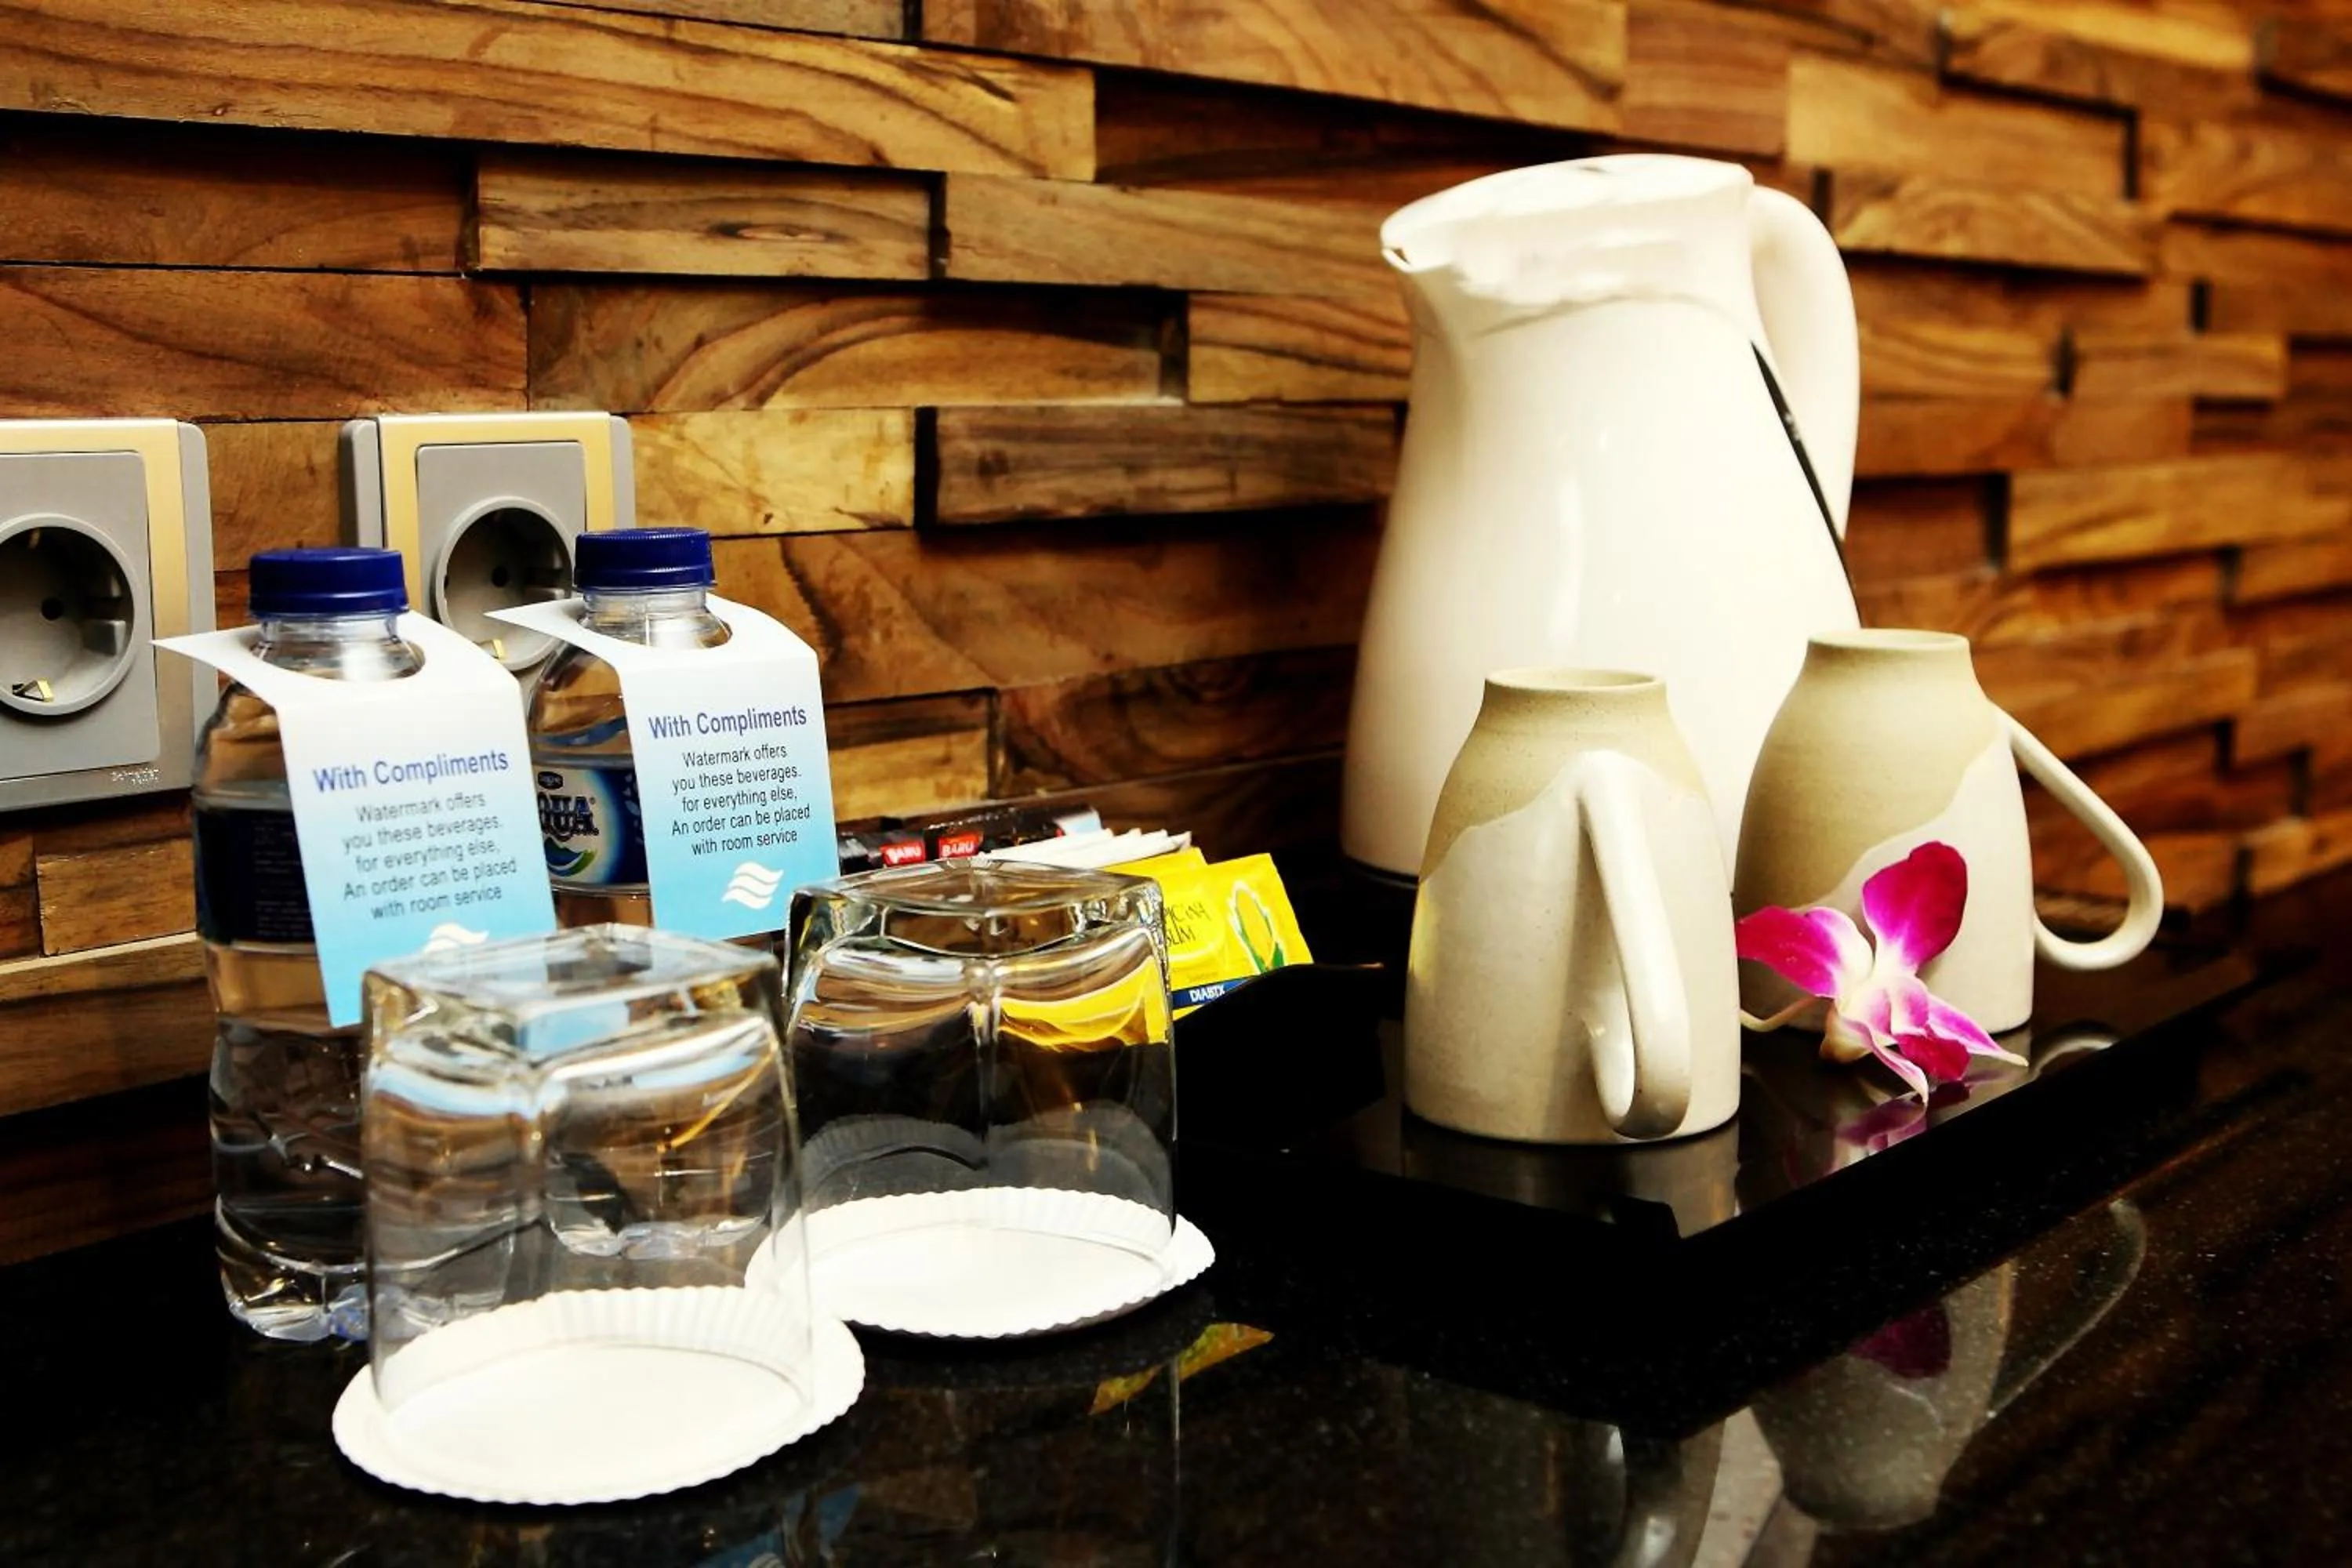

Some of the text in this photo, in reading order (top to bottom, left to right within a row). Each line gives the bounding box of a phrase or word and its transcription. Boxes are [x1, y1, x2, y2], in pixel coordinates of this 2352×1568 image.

[648, 705, 807, 739] With Compliments
[683, 744, 788, 768] Watermark offers
[313, 764, 367, 793] With
[374, 750, 509, 785] Compliments
[672, 779, 695, 796] you
[699, 773, 733, 789] these
[356, 792, 486, 822] Watermark offers
[682, 786, 797, 812] for everything else,
[672, 803, 811, 836] An order can be placed
[342, 833, 372, 855] you
[377, 826, 422, 846] these
[691, 829, 797, 855] with room service
[355, 855, 378, 873] for
[384, 843, 463, 867] everything
[343, 858, 517, 901] An order can be placed
[371, 885, 503, 920] with room service
